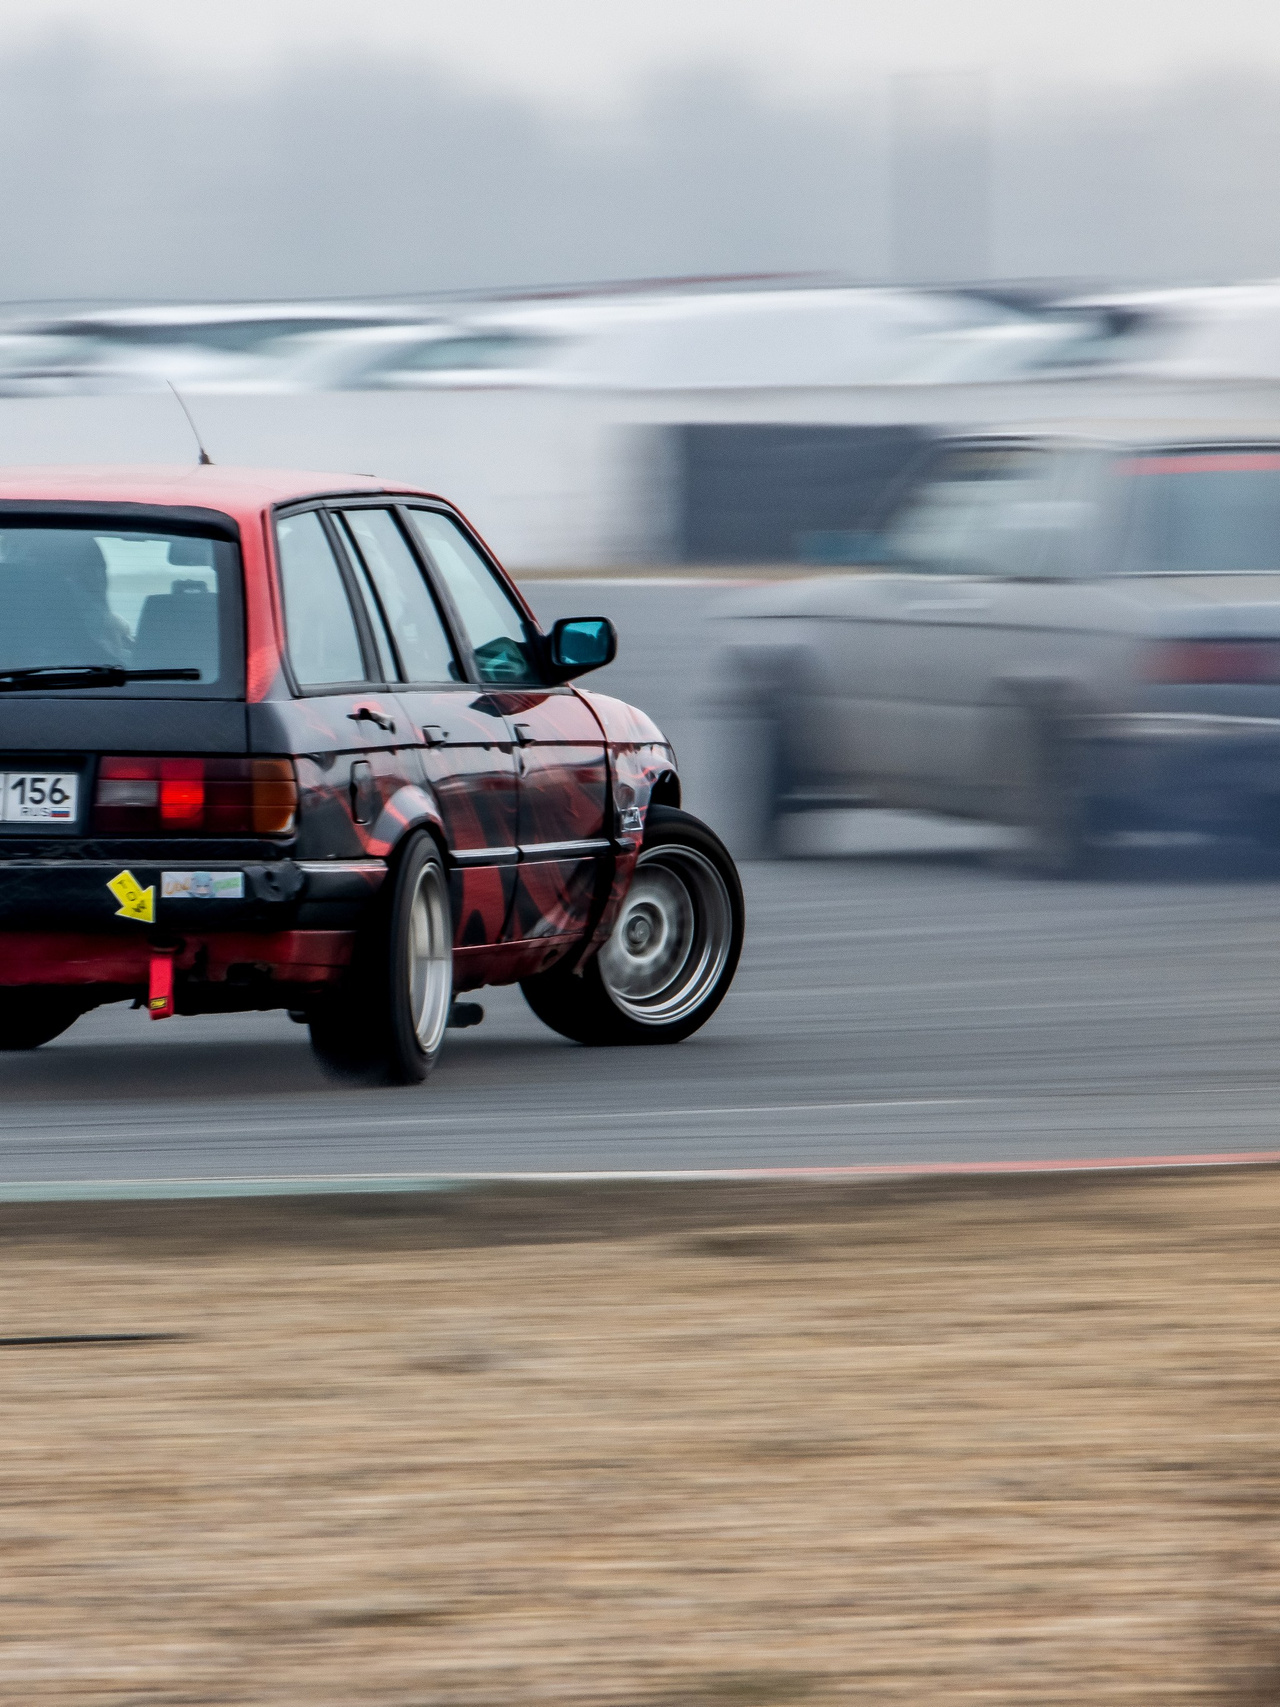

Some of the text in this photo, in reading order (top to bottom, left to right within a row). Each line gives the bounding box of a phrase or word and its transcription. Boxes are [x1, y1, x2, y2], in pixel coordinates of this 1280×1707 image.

[10, 777, 66, 805] 156
[21, 806, 50, 817] RUS
[117, 879, 147, 913] TOW
